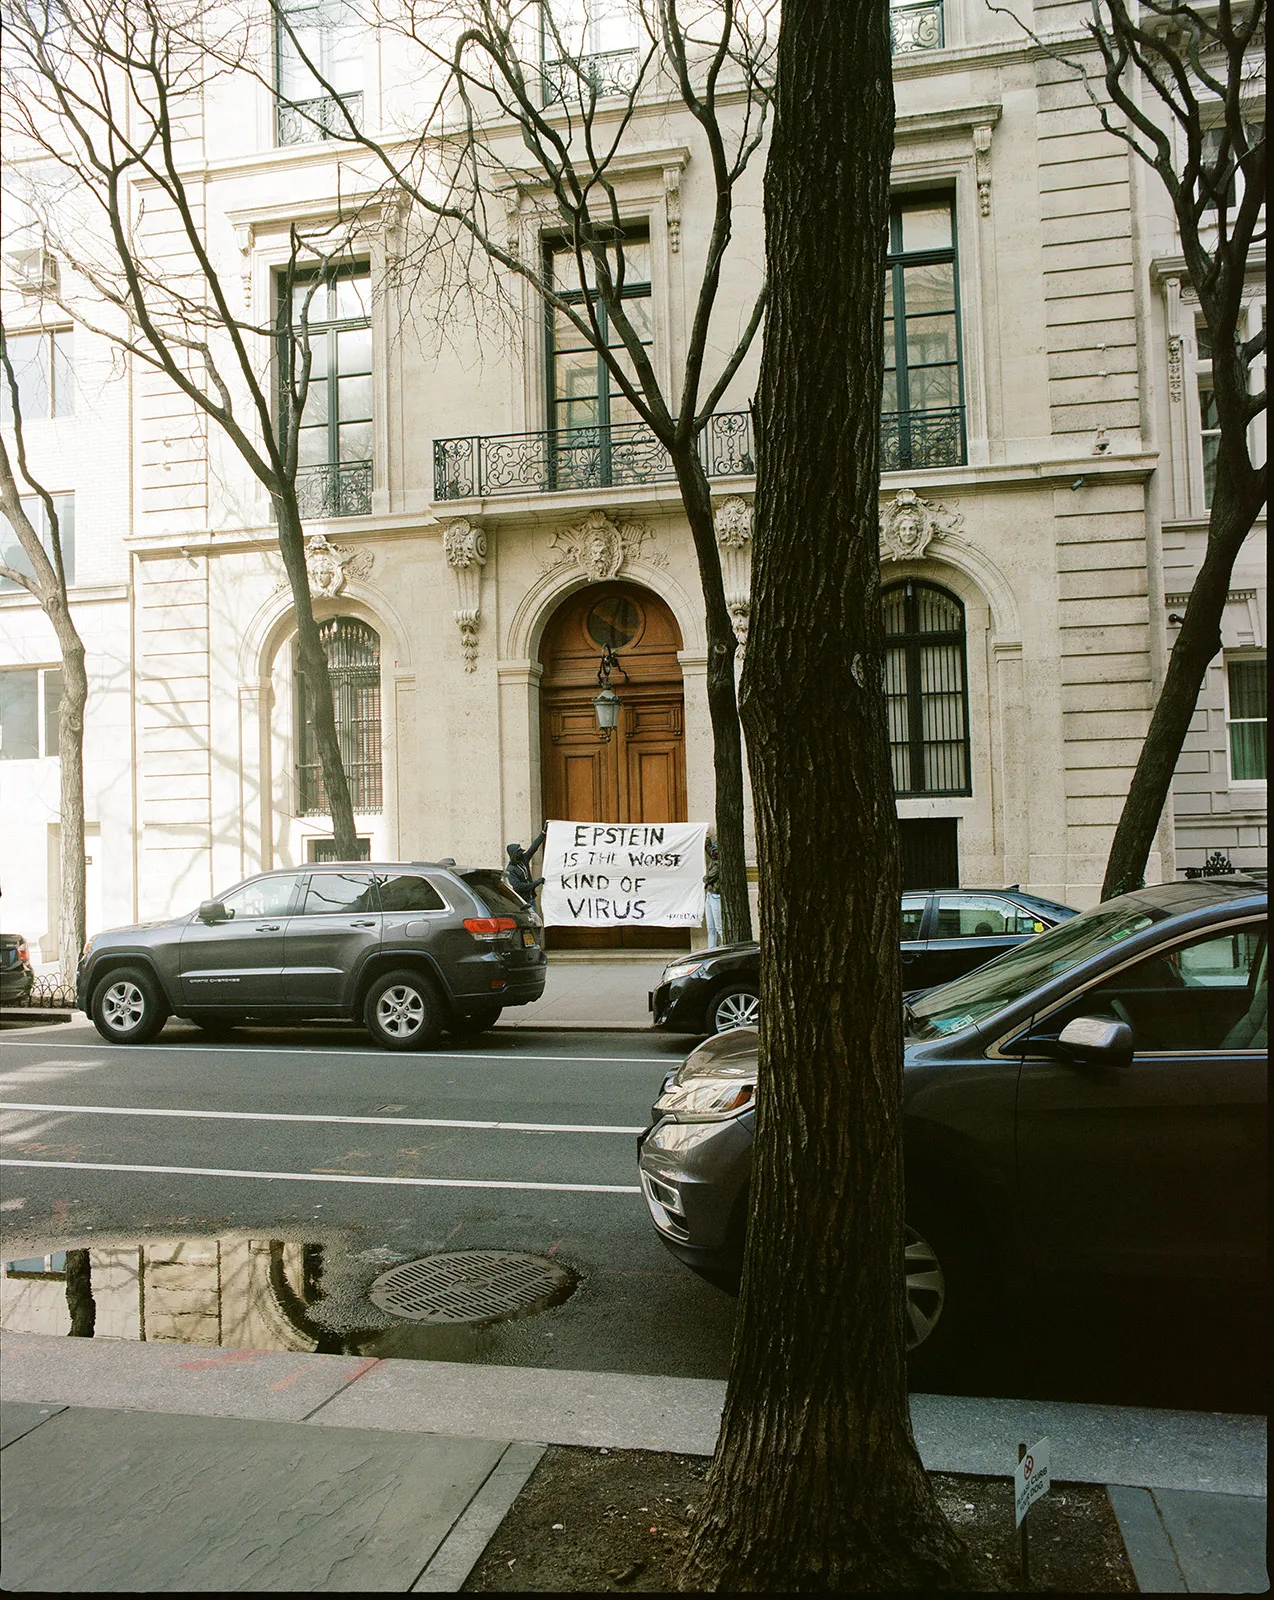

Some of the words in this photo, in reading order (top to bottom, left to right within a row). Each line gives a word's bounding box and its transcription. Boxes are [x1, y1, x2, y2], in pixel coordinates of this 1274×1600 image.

[574, 825, 664, 847] EPSTEIN
[563, 852, 578, 868] IS
[588, 852, 620, 867] THE
[561, 874, 609, 890] KIND
[620, 875, 646, 893] OF
[567, 898, 646, 920] VIRUS
[1031, 1466, 1048, 1485] CURB
[1030, 1480, 1044, 1497] DOG
